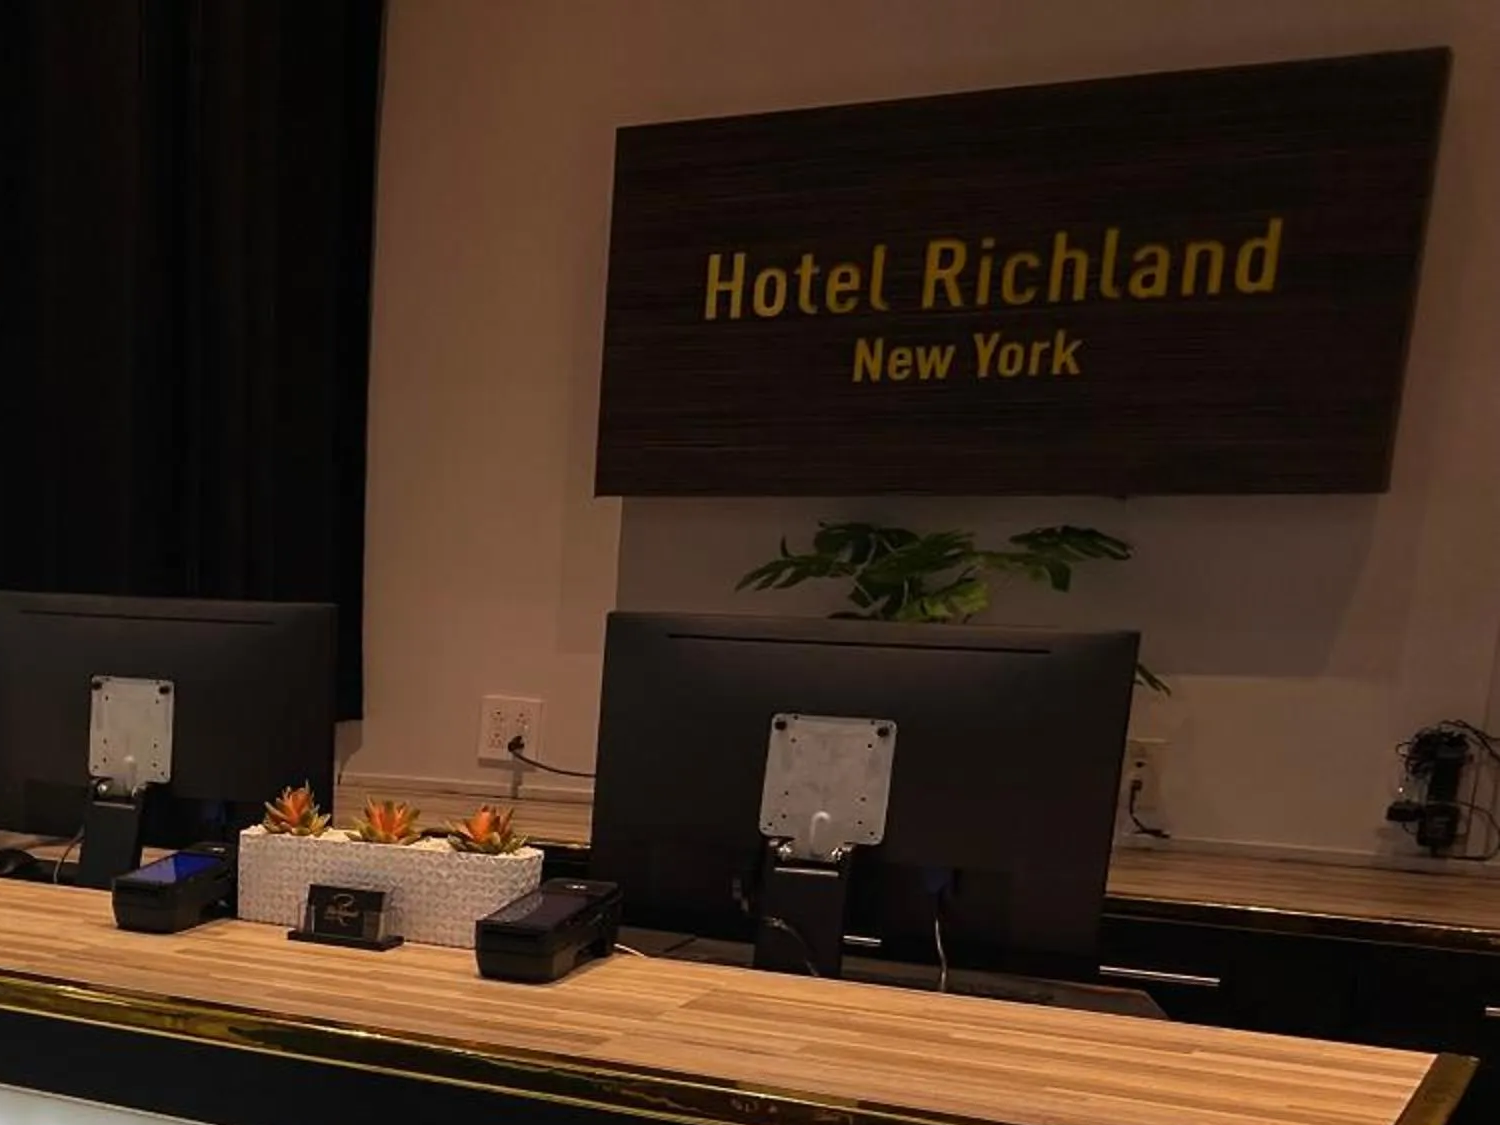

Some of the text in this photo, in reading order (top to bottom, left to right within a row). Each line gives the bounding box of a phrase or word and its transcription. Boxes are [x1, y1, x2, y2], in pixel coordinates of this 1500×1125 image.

[704, 217, 1284, 320] Hotel Richland
[852, 330, 1081, 383] New York
